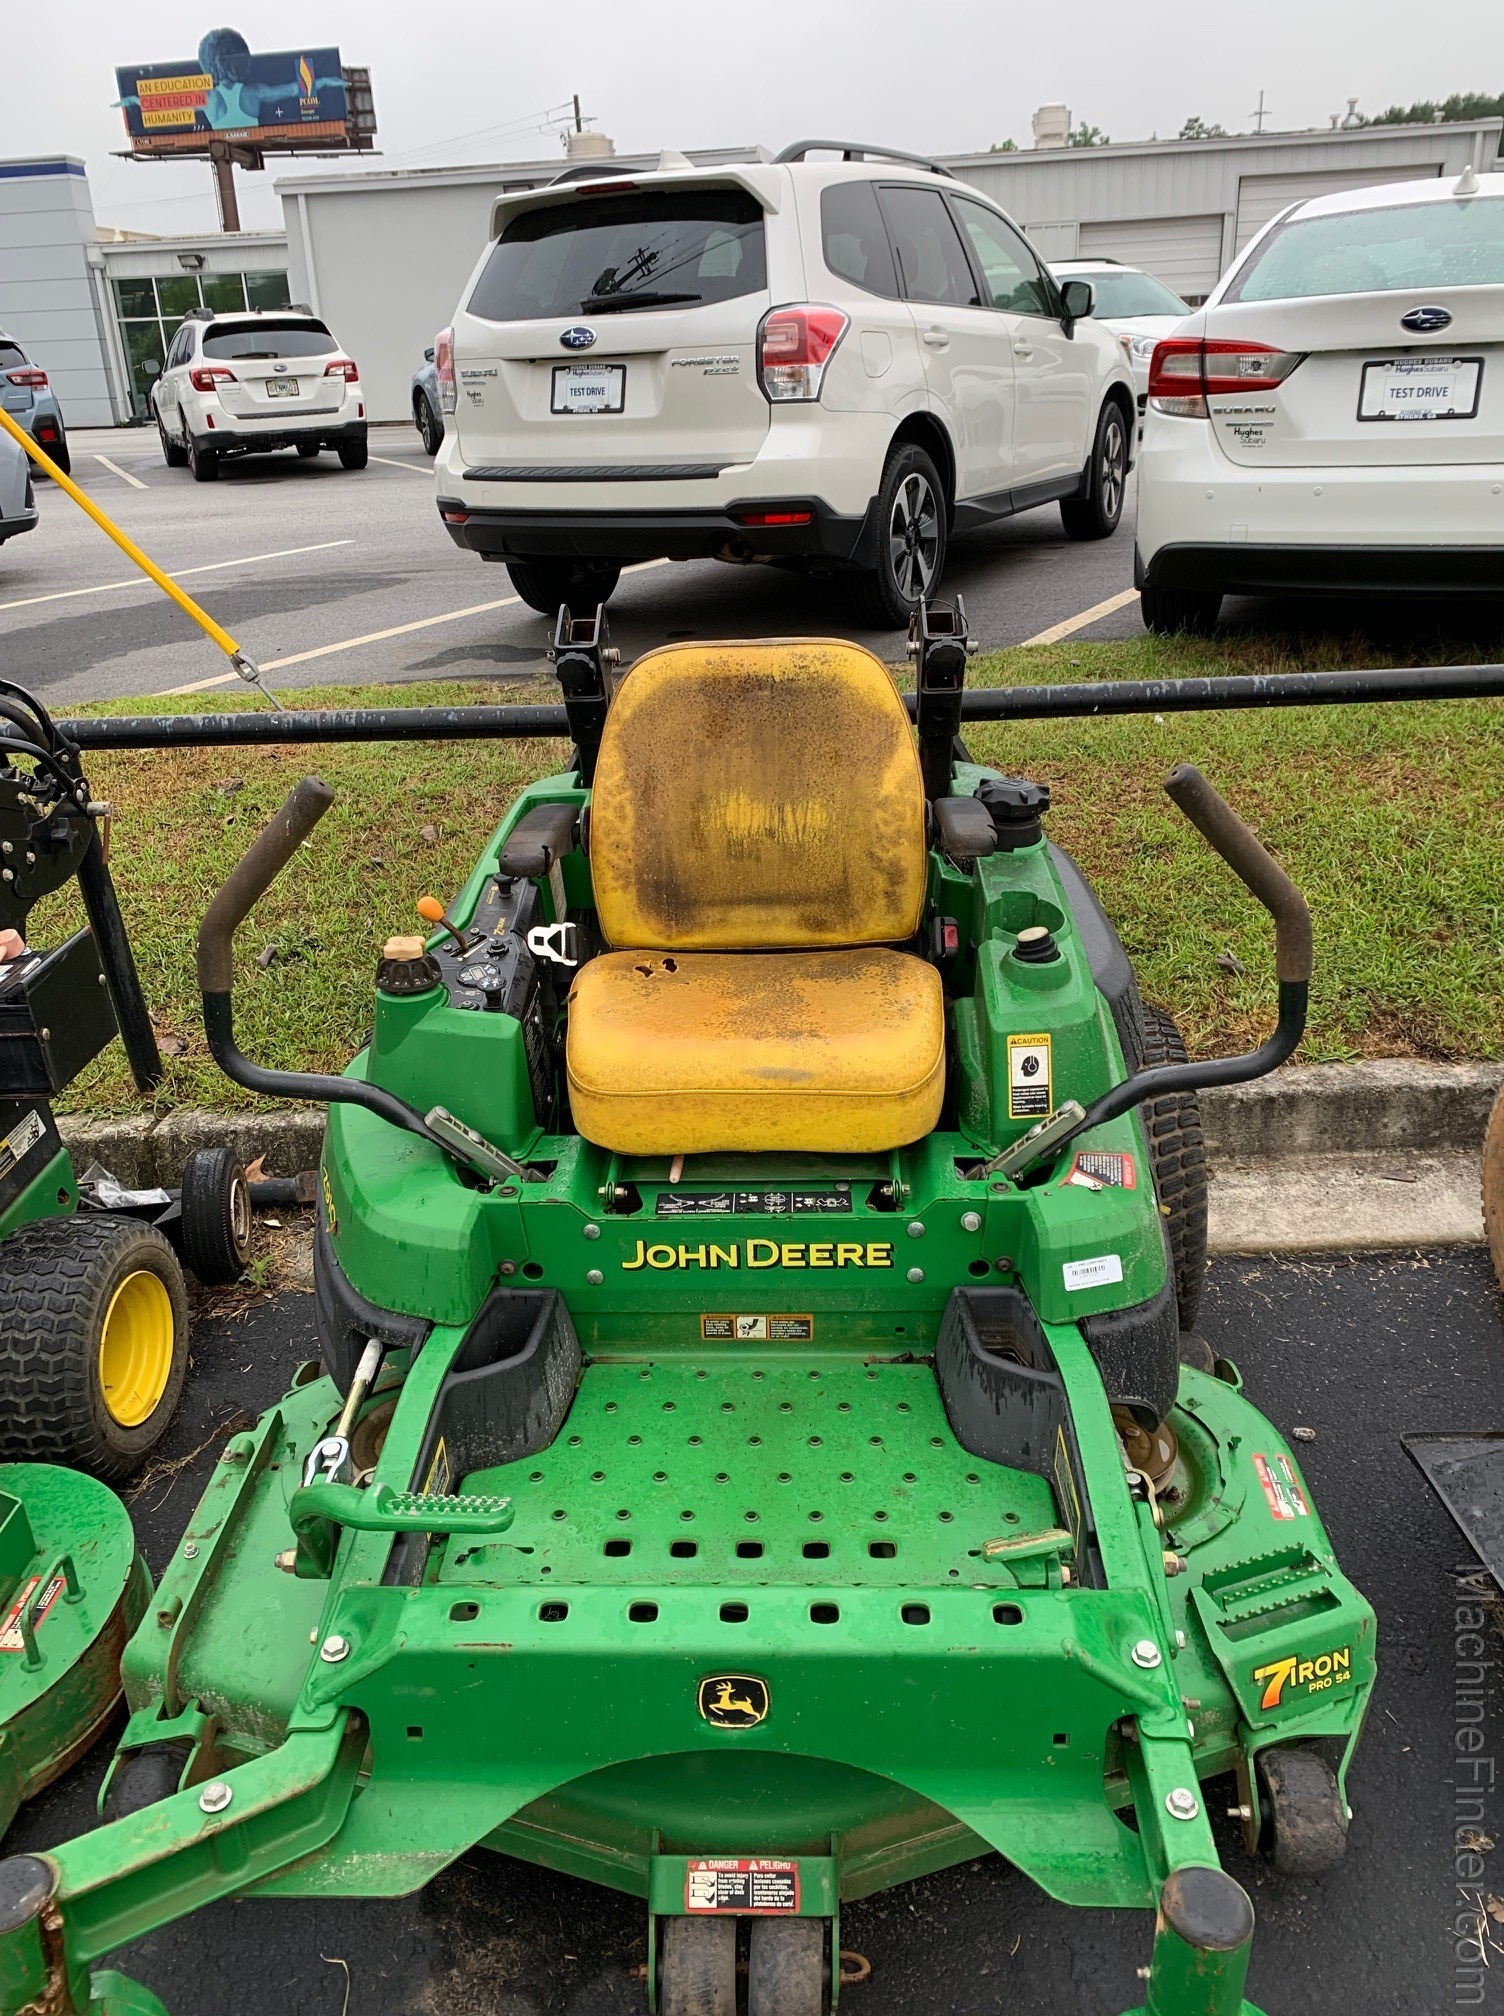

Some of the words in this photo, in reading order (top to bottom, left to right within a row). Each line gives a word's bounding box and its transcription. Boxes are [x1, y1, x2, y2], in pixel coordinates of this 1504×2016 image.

[139, 84, 152, 93] AN
[154, 78, 212, 91] EDUCATION
[141, 96, 192, 109] CENTERED
[195, 95, 206, 106] IN
[144, 111, 193, 124] HUMANITY
[671, 355, 740, 367] FORESTER
[570, 388, 585, 397] TEST
[586, 387, 606, 396] DRIVE
[1390, 387, 1415, 398] TEST
[1416, 386, 1449, 398] DRIVE
[1213, 405, 1276, 414] SUBARU
[1234, 427, 1263, 438] Hughes
[1017, 1037, 1049, 1045] CAUTION
[621, 1240, 739, 1269] JOHN
[746, 1238, 892, 1269] DEERE
[1308, 1677, 1333, 1694] PRO
[1335, 1671, 1351, 1684] 54
[708, 1860, 739, 1869] DANGER
